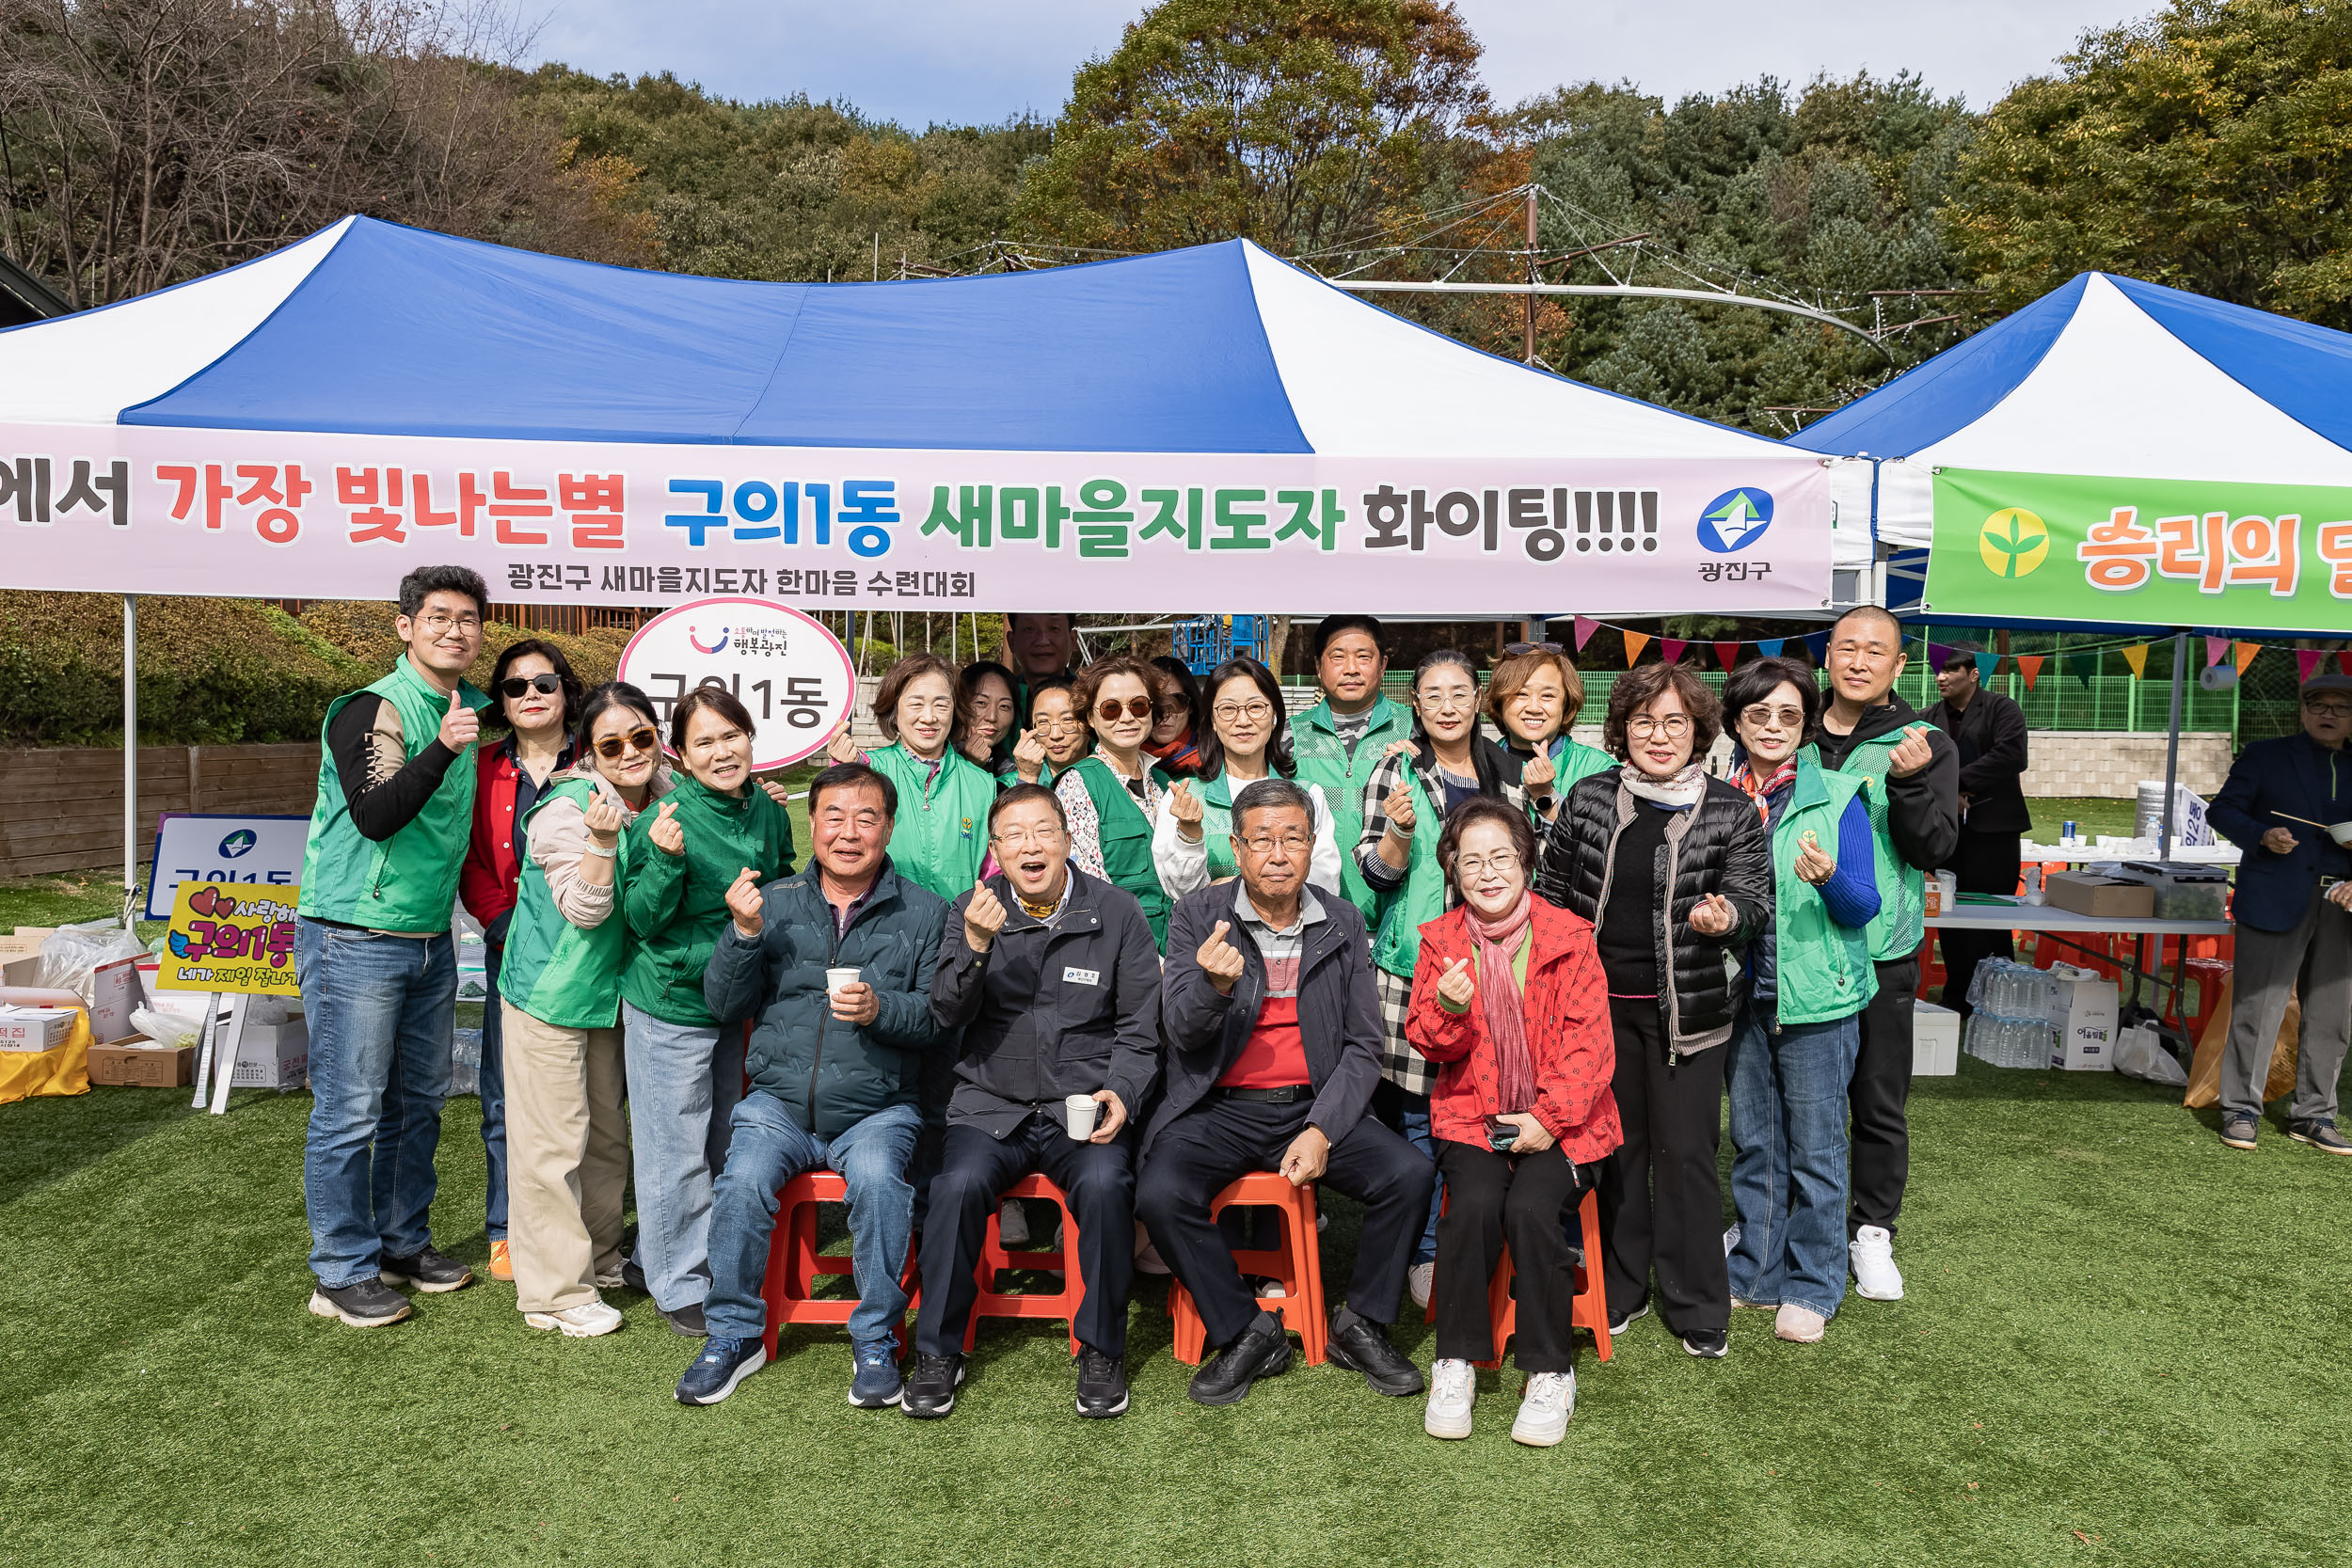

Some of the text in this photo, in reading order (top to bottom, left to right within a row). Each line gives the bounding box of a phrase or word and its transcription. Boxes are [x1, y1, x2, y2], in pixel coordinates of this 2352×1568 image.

[0, 458, 1659, 562] 에서 가장 빛나는별 구의1동 새마을지도자 화이팅!!!!
[2081, 511, 2297, 594] 승리의
[507, 564, 976, 598] 광진구 새마을지도자 한마음 수련대회
[1698, 562, 1772, 582] 광진구
[734, 637, 787, 657] 행복광진
[183, 920, 296, 968] 구의1동
[177, 966, 215, 981] 네가
[215, 966, 252, 987] 제일
